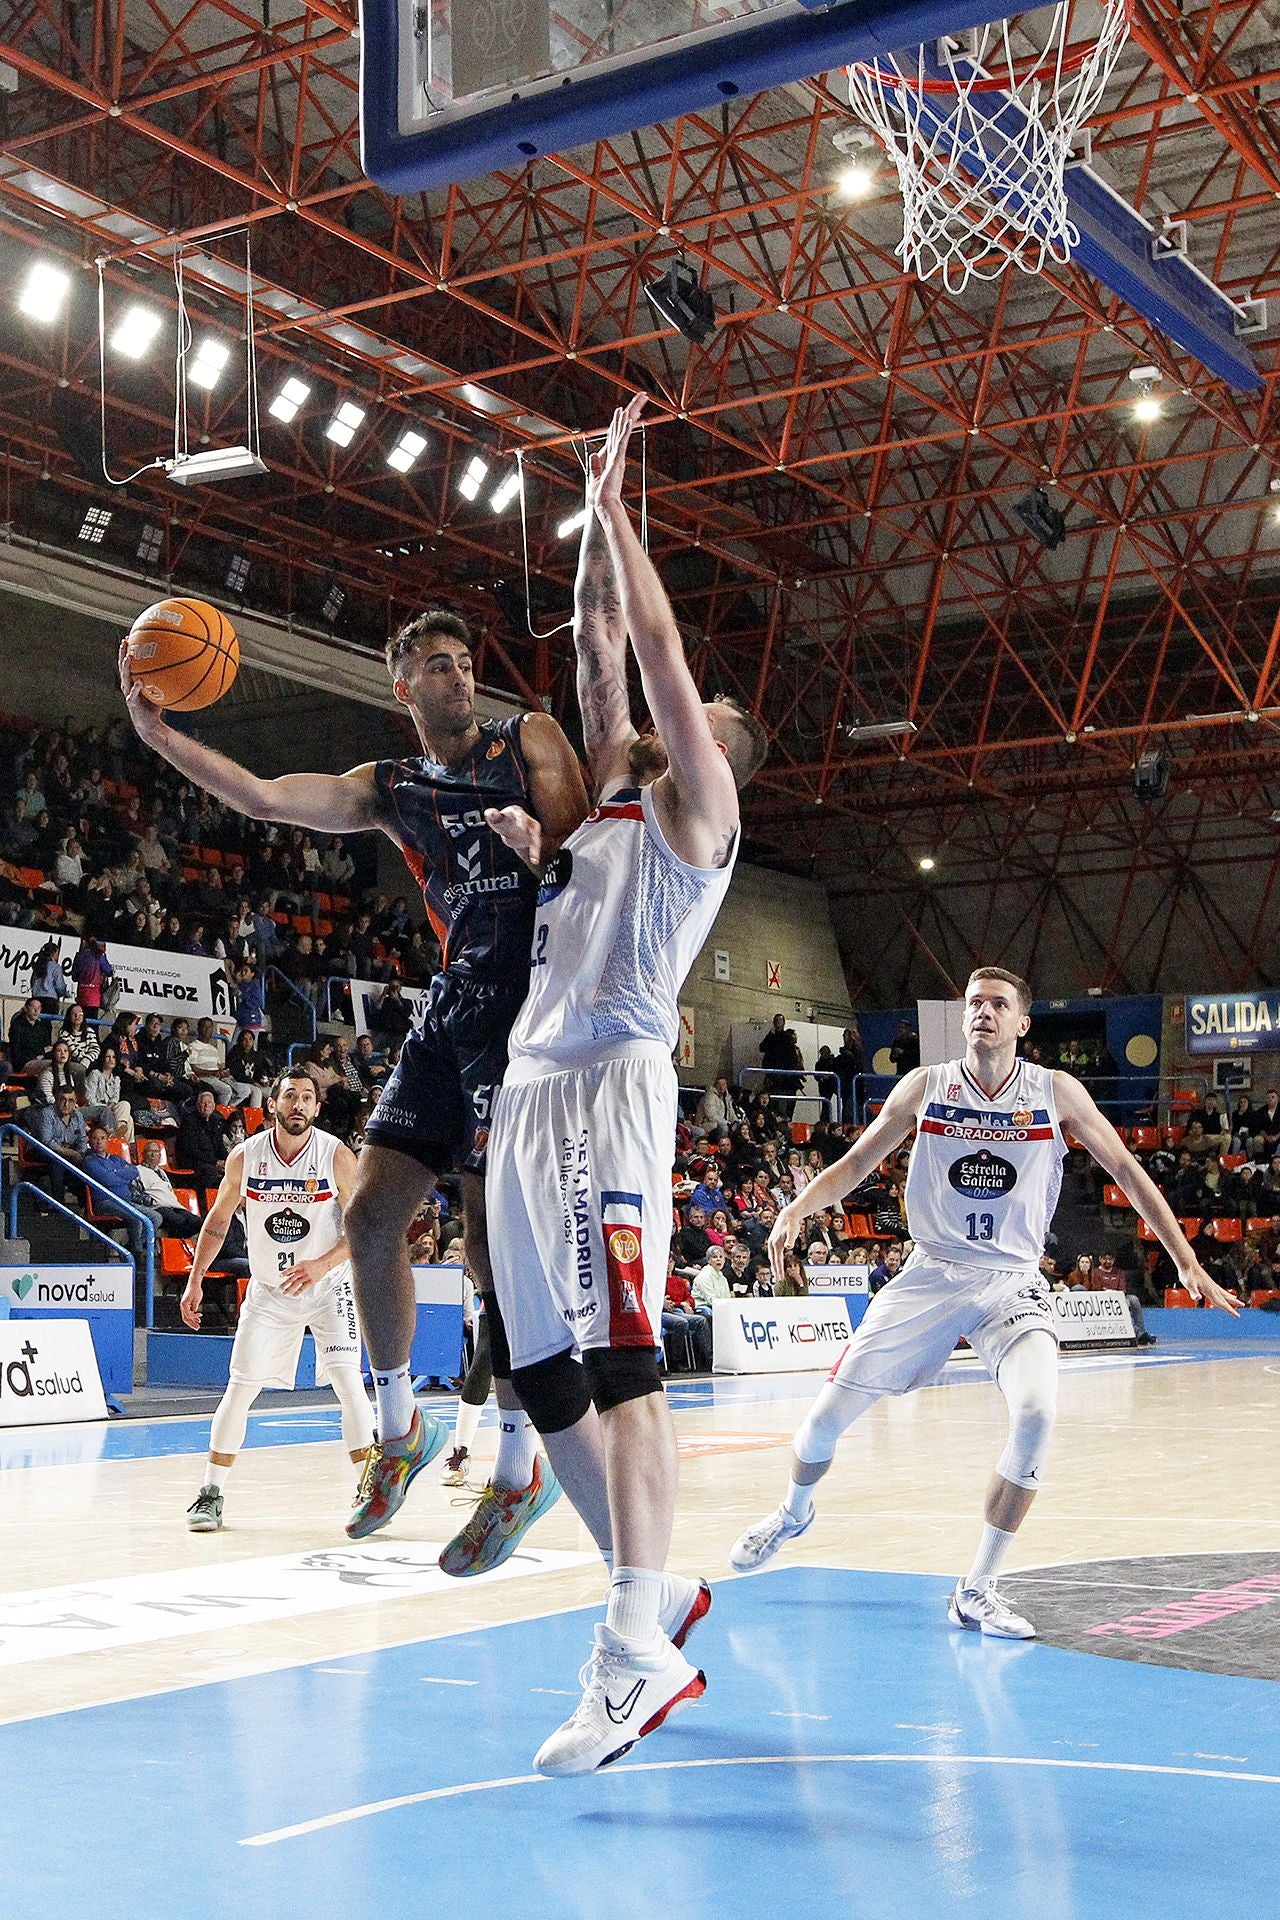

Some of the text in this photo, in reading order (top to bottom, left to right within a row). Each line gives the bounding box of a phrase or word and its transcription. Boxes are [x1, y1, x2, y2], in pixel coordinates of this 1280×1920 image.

[156, 970, 181, 979] ASADOR
[139, 980, 198, 1002] ALFOZ
[1191, 1001, 1272, 1035] SALIDA
[944, 1126, 1027, 1141] OBRADOIRO
[960, 1162, 1007, 1177] Estrella
[960, 1174, 1004, 1188] Galicia
[258, 1192, 316, 1204] OBRADOIRO
[272, 1216, 303, 1228] Estrella
[966, 1212, 995, 1241] 13
[273, 1224, 302, 1236] Galicia
[574, 1188, 593, 1291] MADRID
[278, 1251, 295, 1272] 21
[89, 1290, 114, 1302] salud
[36, 1371, 83, 1397] salud
